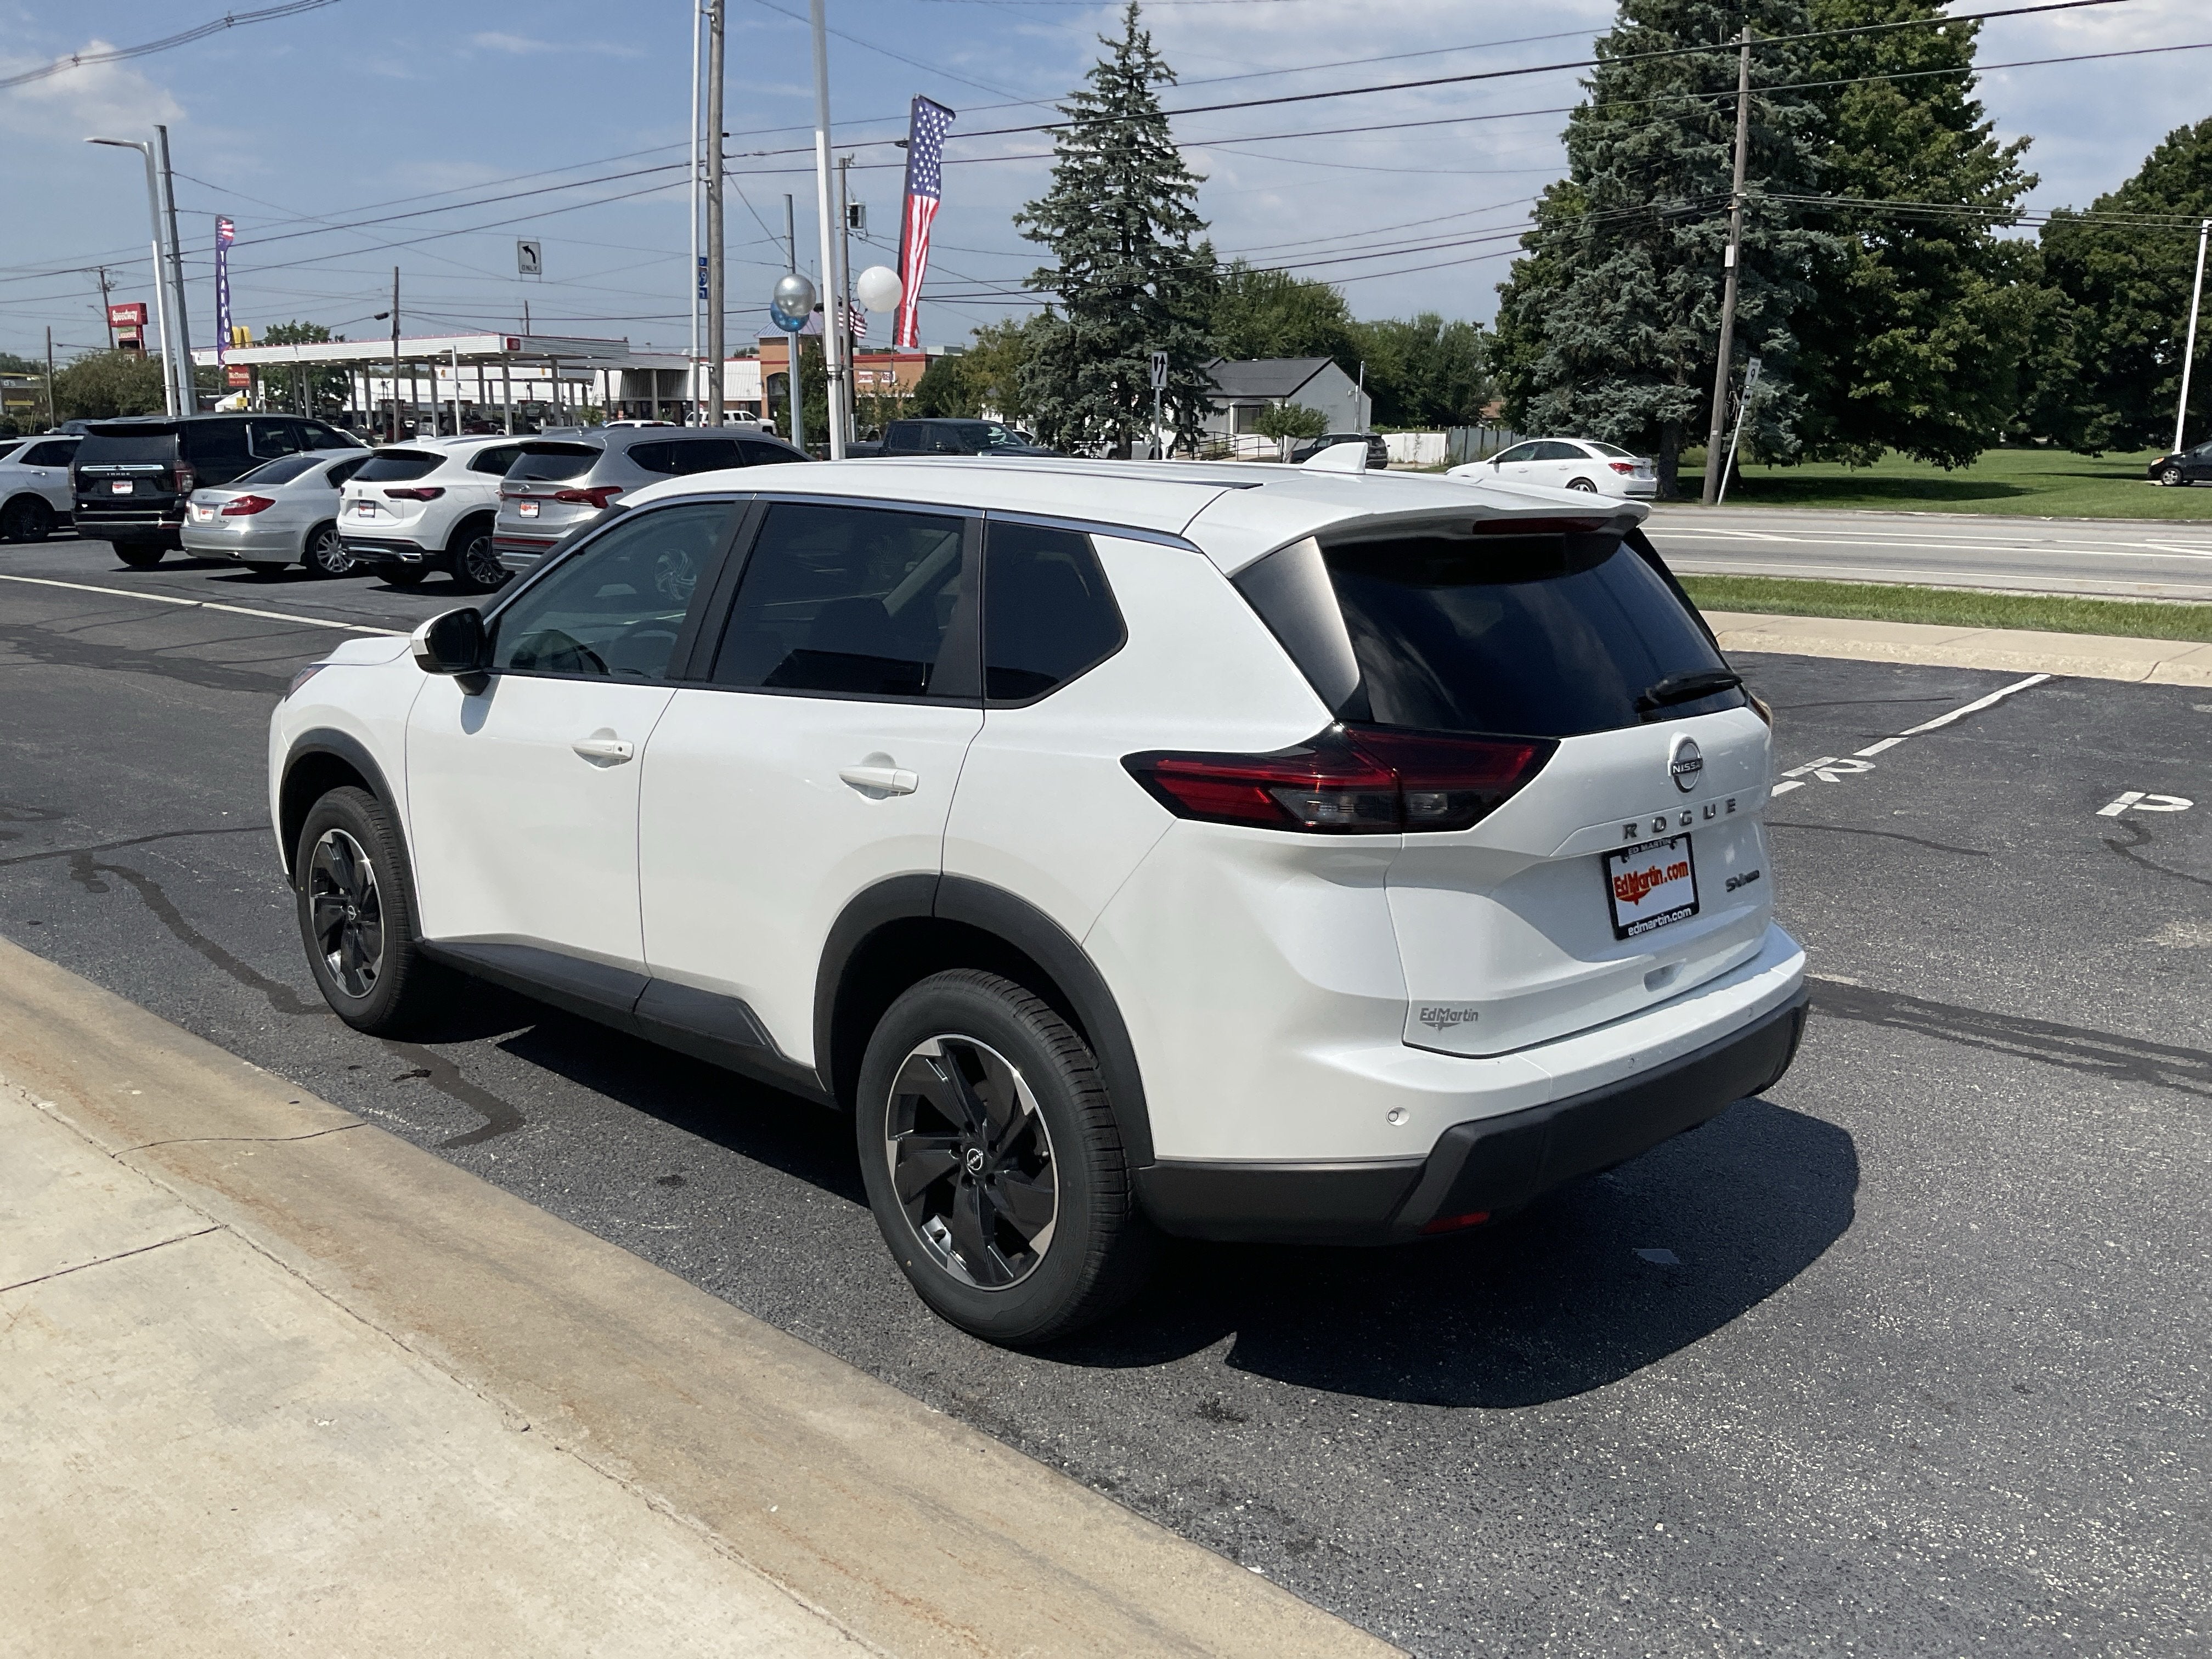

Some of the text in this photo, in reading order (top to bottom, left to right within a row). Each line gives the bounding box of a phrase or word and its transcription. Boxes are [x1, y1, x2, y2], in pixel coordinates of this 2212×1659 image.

[1750, 368, 1756, 382] 9
[1673, 761, 1702, 773] NISSA
[1622, 798, 1736, 840] ROGUE
[1628, 838, 1672, 855] ED MARTIN
[1613, 861, 1689, 898] EdMartin.com
[1628, 907, 1691, 936] edmartin.com
[1420, 1008, 1479, 1022] EdMartin
